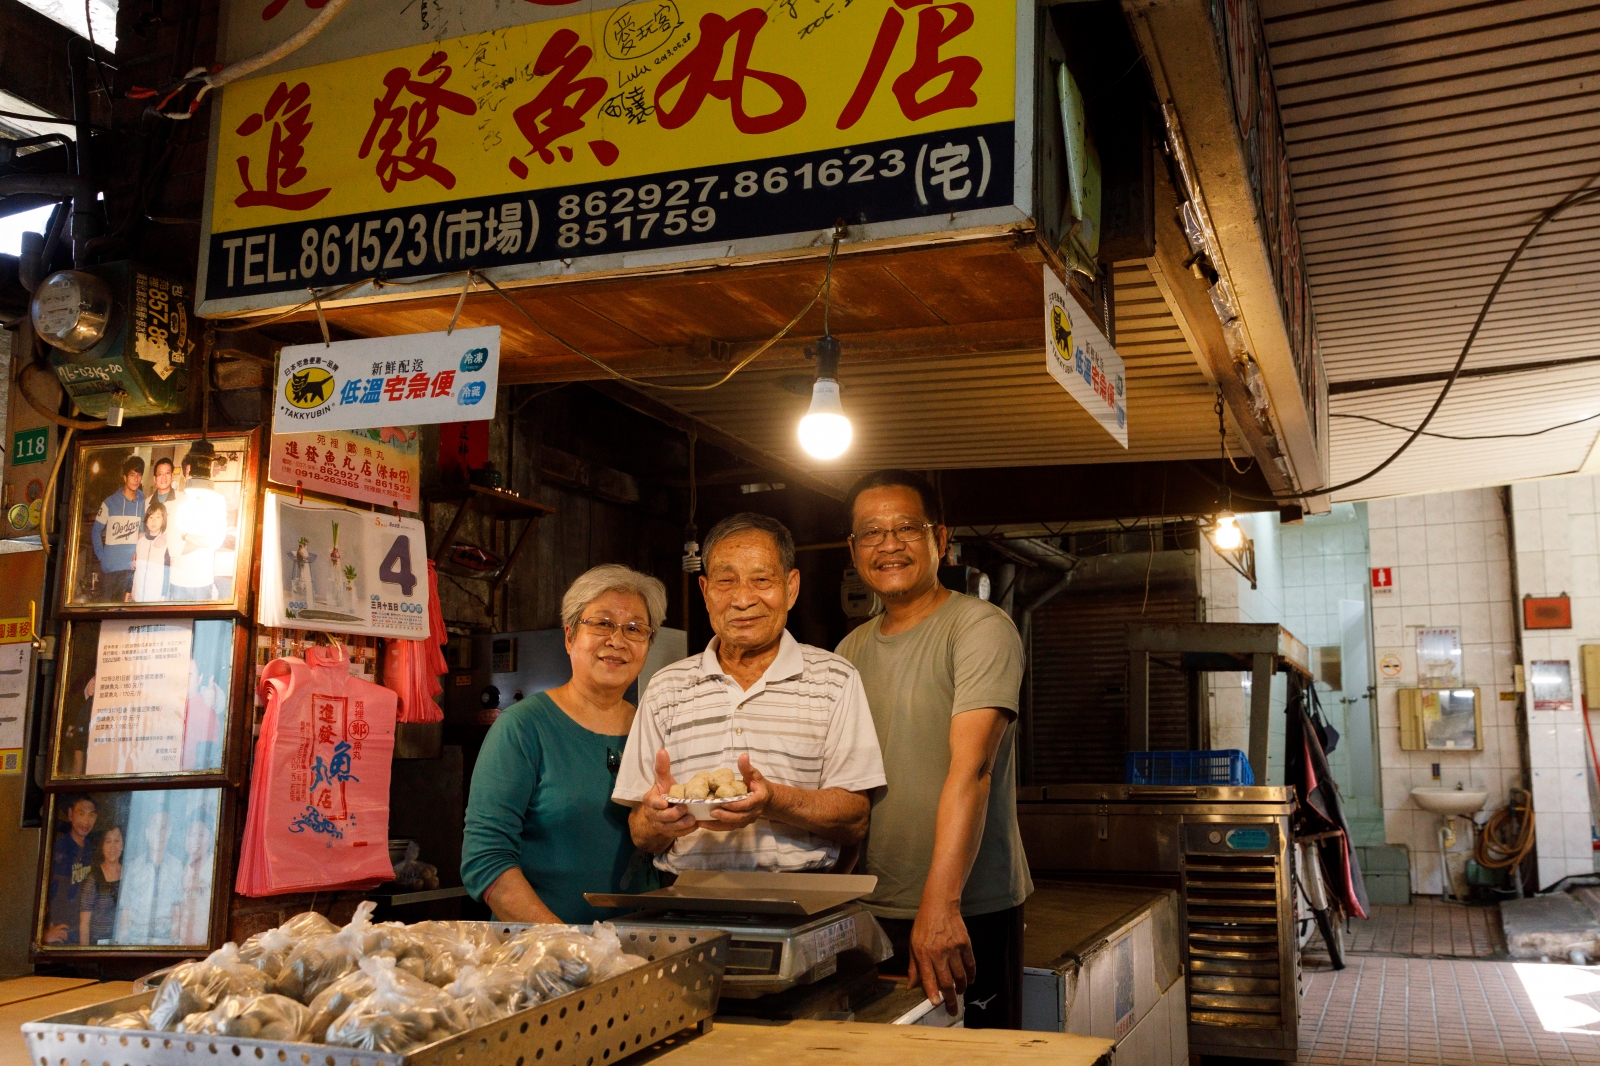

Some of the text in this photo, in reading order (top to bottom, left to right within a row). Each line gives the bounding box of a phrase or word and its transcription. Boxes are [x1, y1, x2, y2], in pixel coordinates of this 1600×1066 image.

[613, 4, 672, 57] 愛玩客
[617, 64, 652, 88] Lulu
[232, 0, 983, 212] 進發魚丸店
[557, 206, 716, 249] 851759
[222, 199, 540, 288] TEL.861523(市場)
[371, 358, 425, 376] 新鮮配送
[464, 352, 484, 365] 冷凍
[339, 369, 457, 406] 低溫宅急便
[461, 386, 481, 398] 冷藏
[284, 405, 332, 420] TAKKYUBIN
[16, 436, 45, 458] 118
[295, 468, 360, 488] 0918-263365
[320, 466, 360, 481] 862927
[375, 478, 411, 494] 861523
[375, 516, 381, 526] 5
[379, 535, 417, 597] 4
[371, 601, 399, 611] 三月十五日
